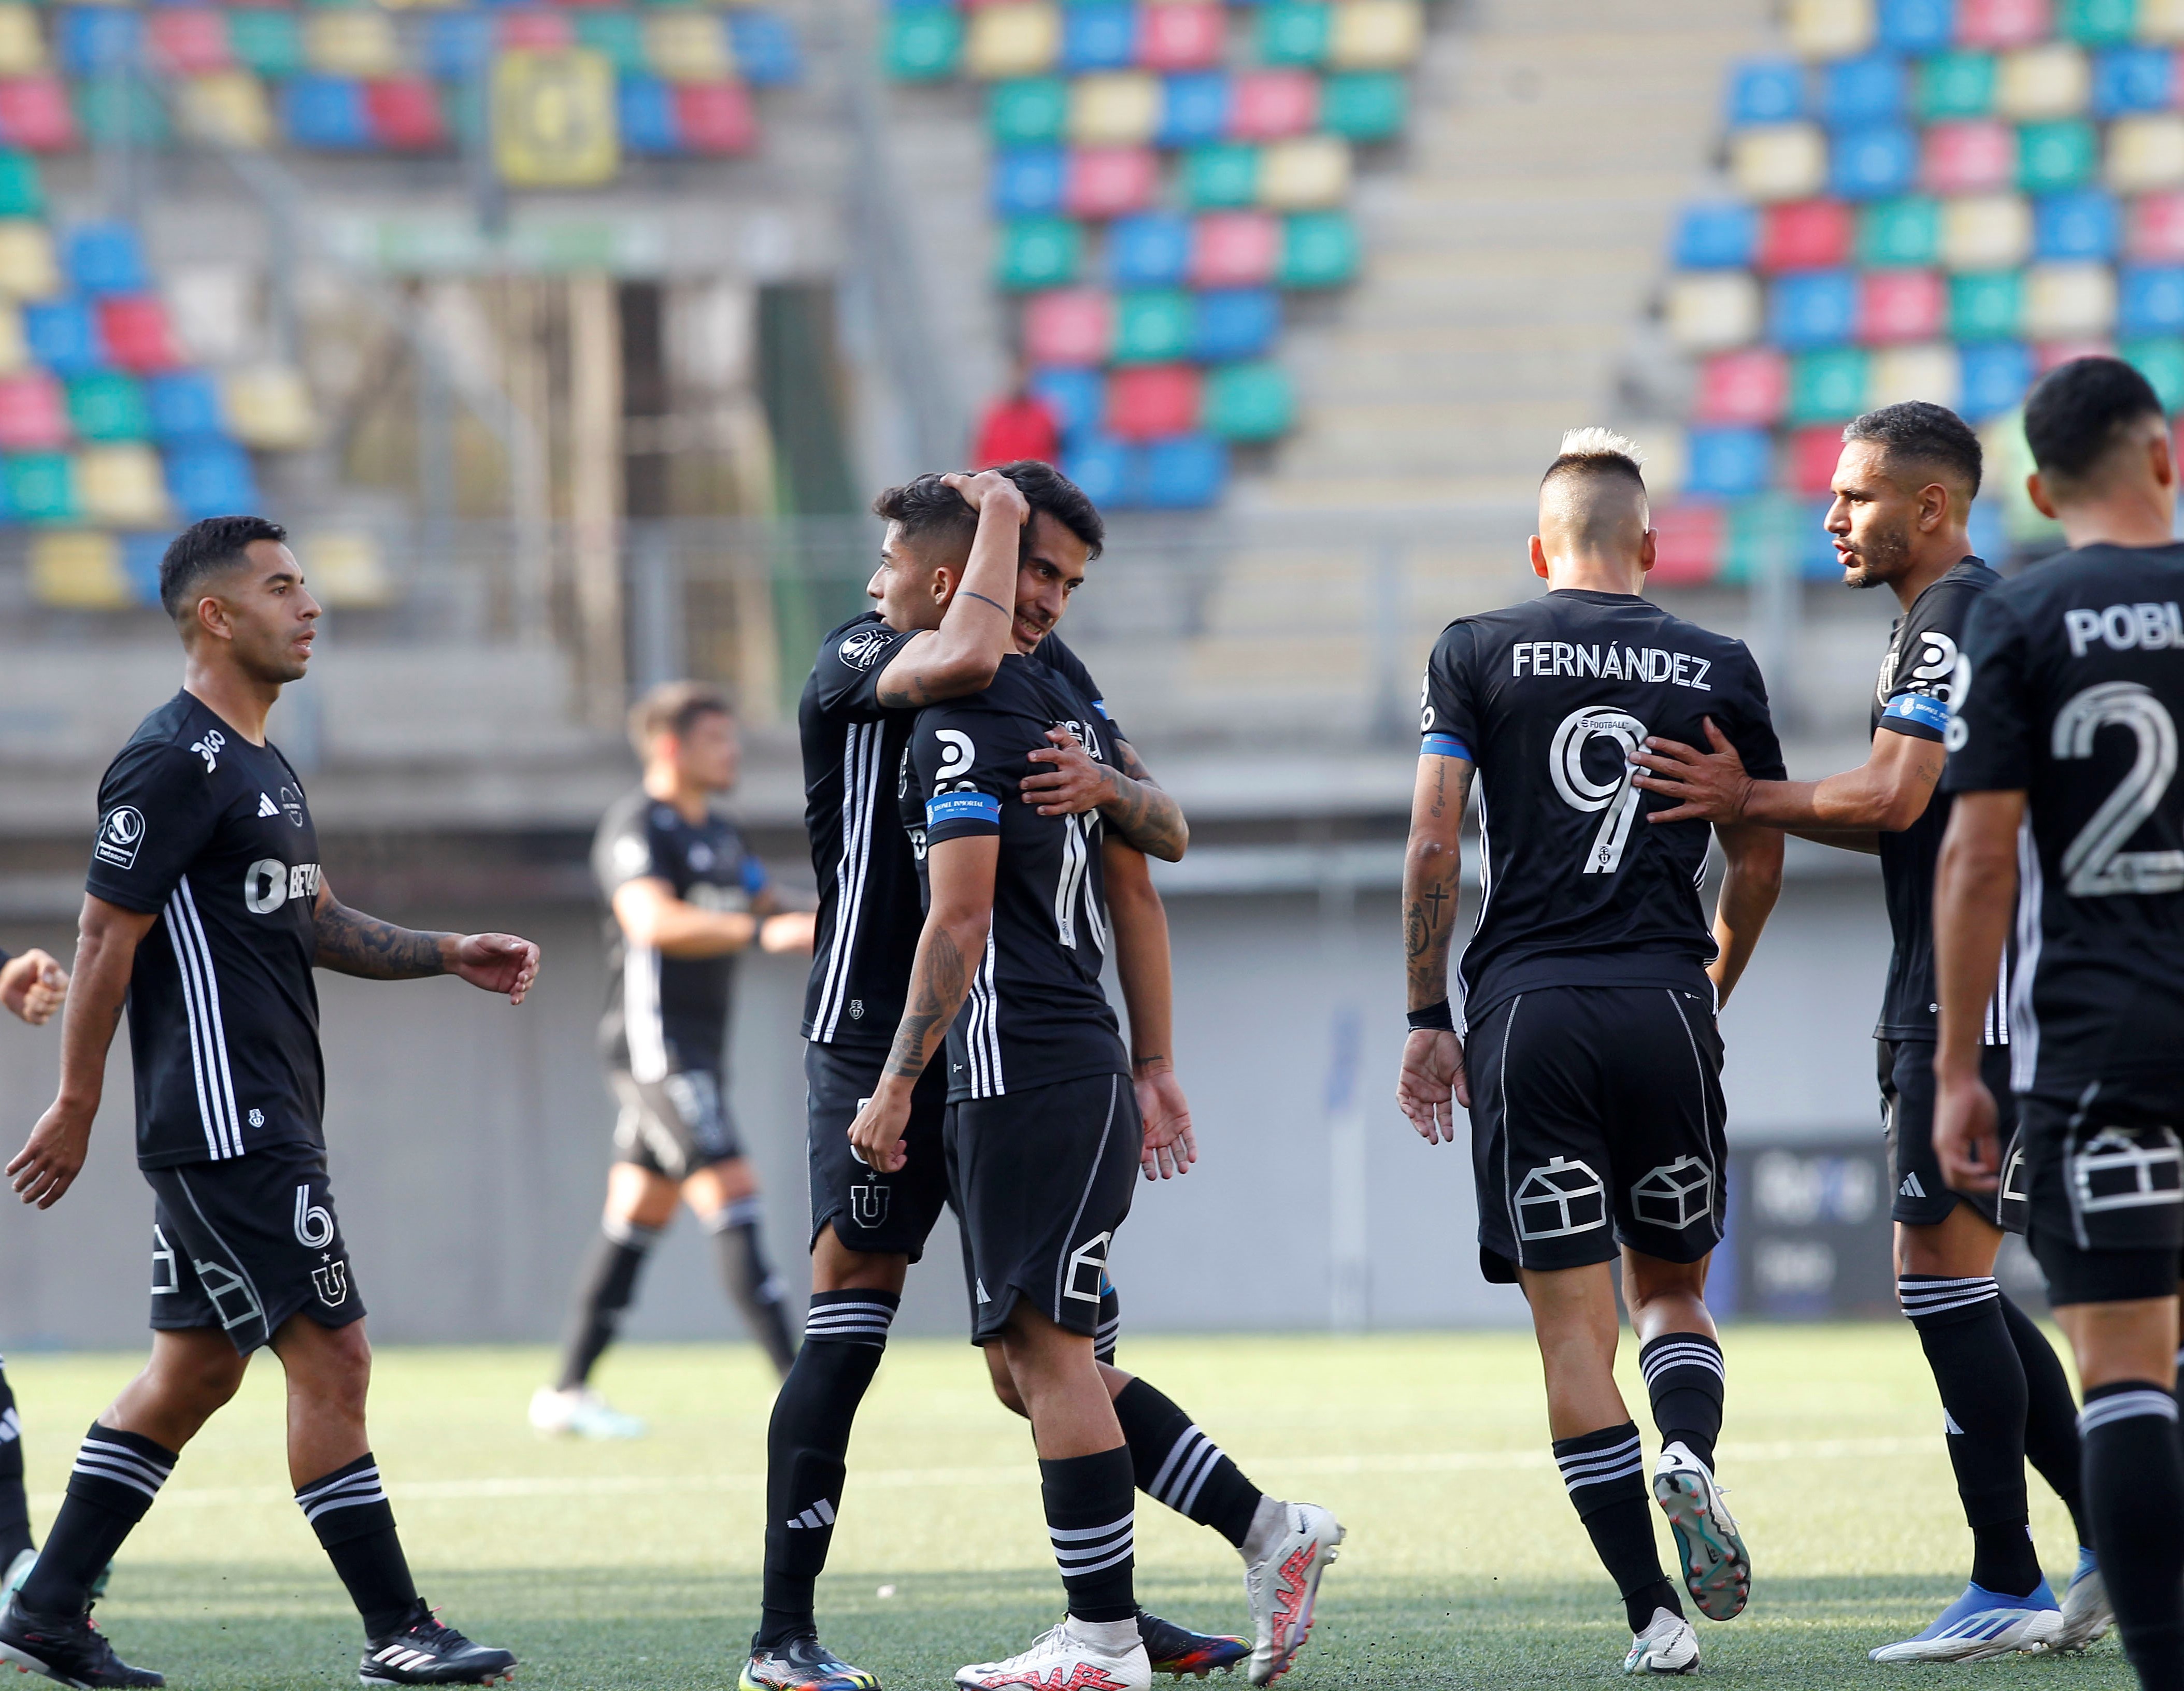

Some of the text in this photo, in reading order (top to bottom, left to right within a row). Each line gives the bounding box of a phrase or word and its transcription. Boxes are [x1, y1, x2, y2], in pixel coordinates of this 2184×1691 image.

[1513, 640, 1711, 691] FERNÁNDEZ
[1549, 705, 1652, 873] 9
[2051, 680, 2184, 897] 2
[293, 1184, 334, 1249] 6
[850, 1185, 890, 1228] U
[312, 1260, 347, 1307] U
